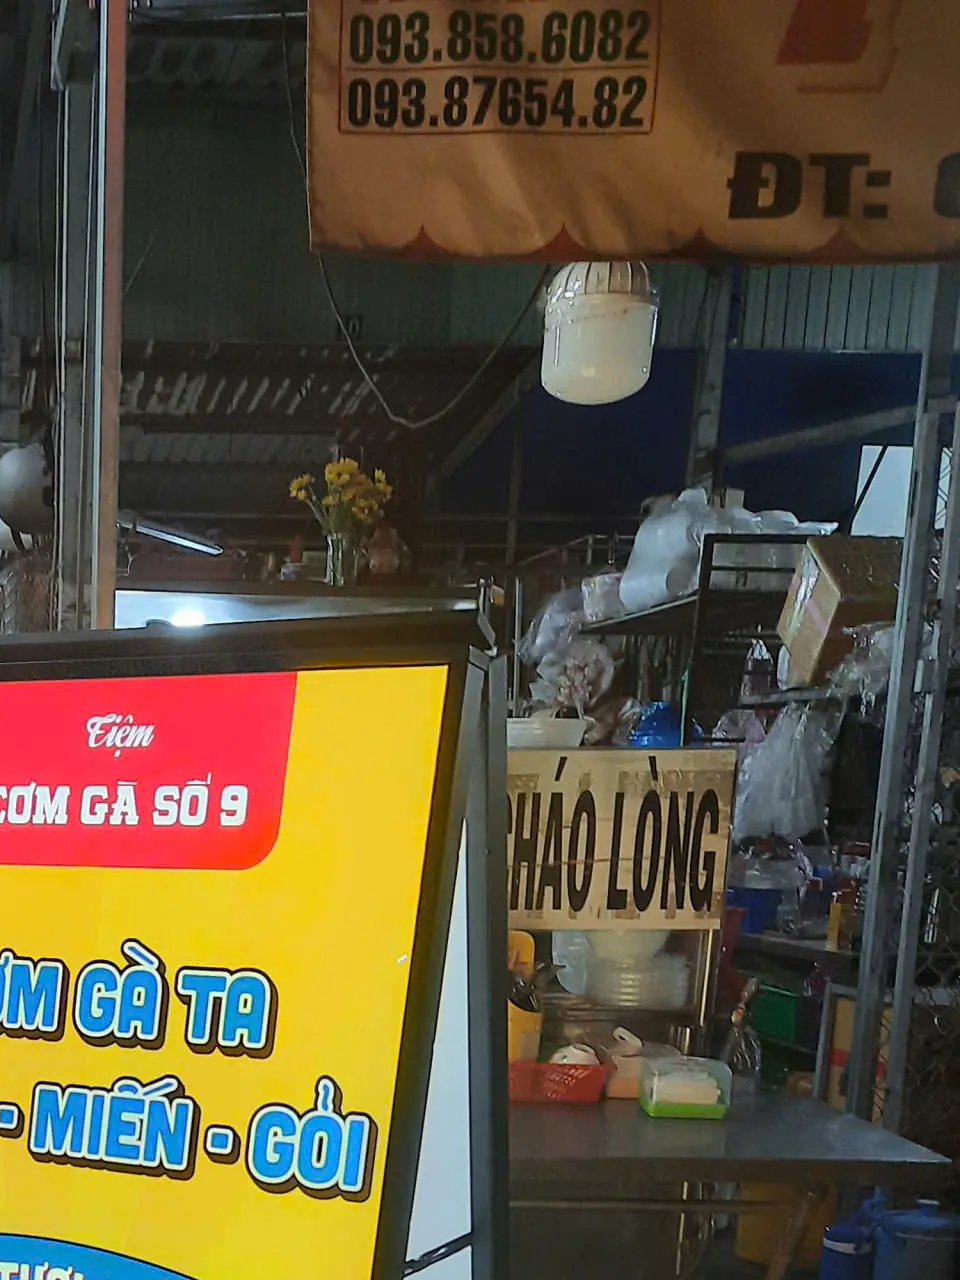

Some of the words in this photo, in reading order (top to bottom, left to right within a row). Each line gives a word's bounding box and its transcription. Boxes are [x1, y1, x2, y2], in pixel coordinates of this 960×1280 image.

[349, 9, 651, 64] 093.858.6082
[347, 75, 648, 128] 093.87654.82
[726, 151, 892, 220] ĐT:
[86, 713, 156, 758] Tiệm
[152, 772, 212, 827] SỐ
[219, 785, 249, 827] 9
[506, 756, 596, 912] HÁO
[606, 756, 720, 912] LÒNG
[74, 938, 167, 1051] GÀ
[176, 967, 278, 1060] TA
[28, 1074, 200, 1181] MIẾN
[245, 1076, 378, 1203] GỎI
